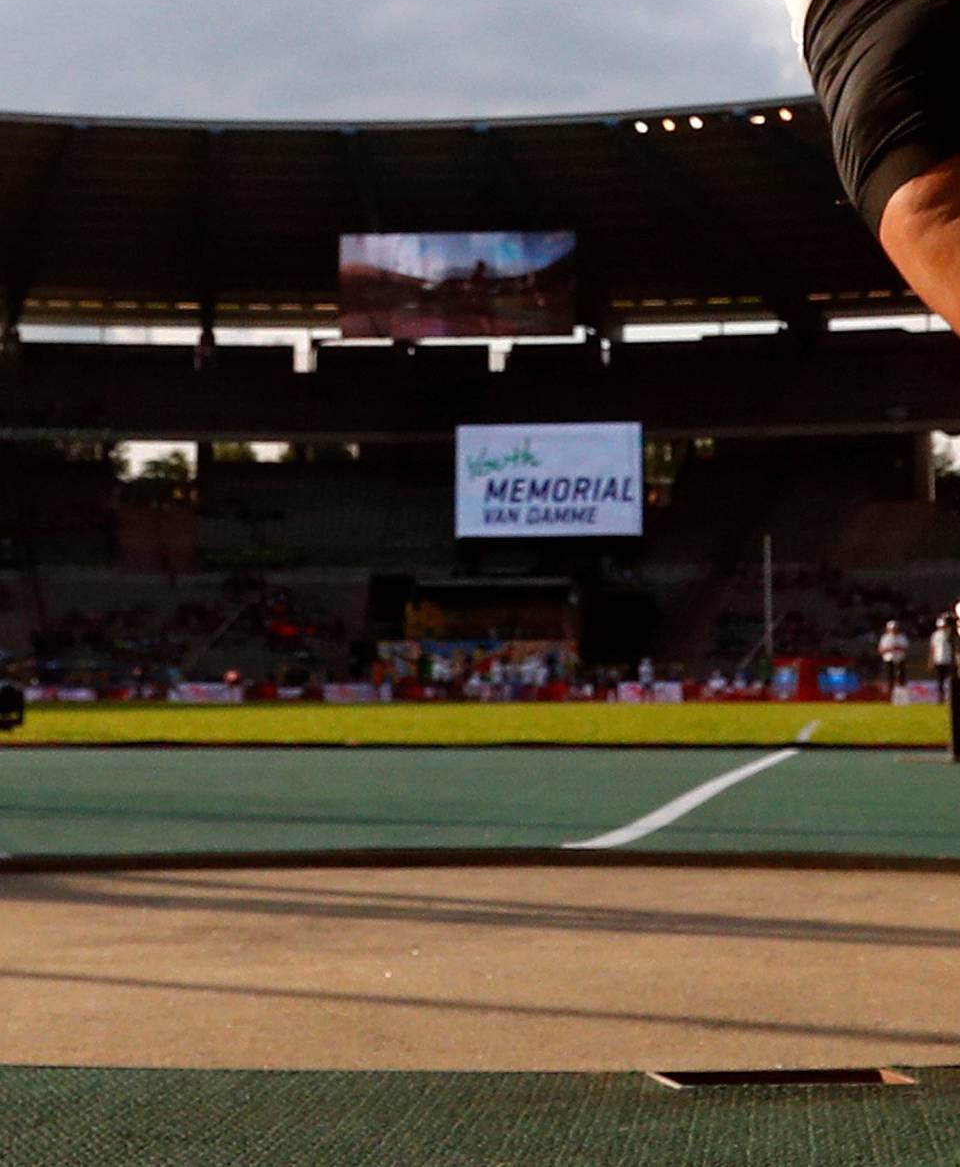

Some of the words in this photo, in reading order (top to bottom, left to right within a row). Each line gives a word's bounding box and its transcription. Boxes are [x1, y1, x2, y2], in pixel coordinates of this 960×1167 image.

[483, 476, 635, 503] MEMORIAL
[483, 506, 519, 525] VAN
[525, 505, 598, 525] DAMME
